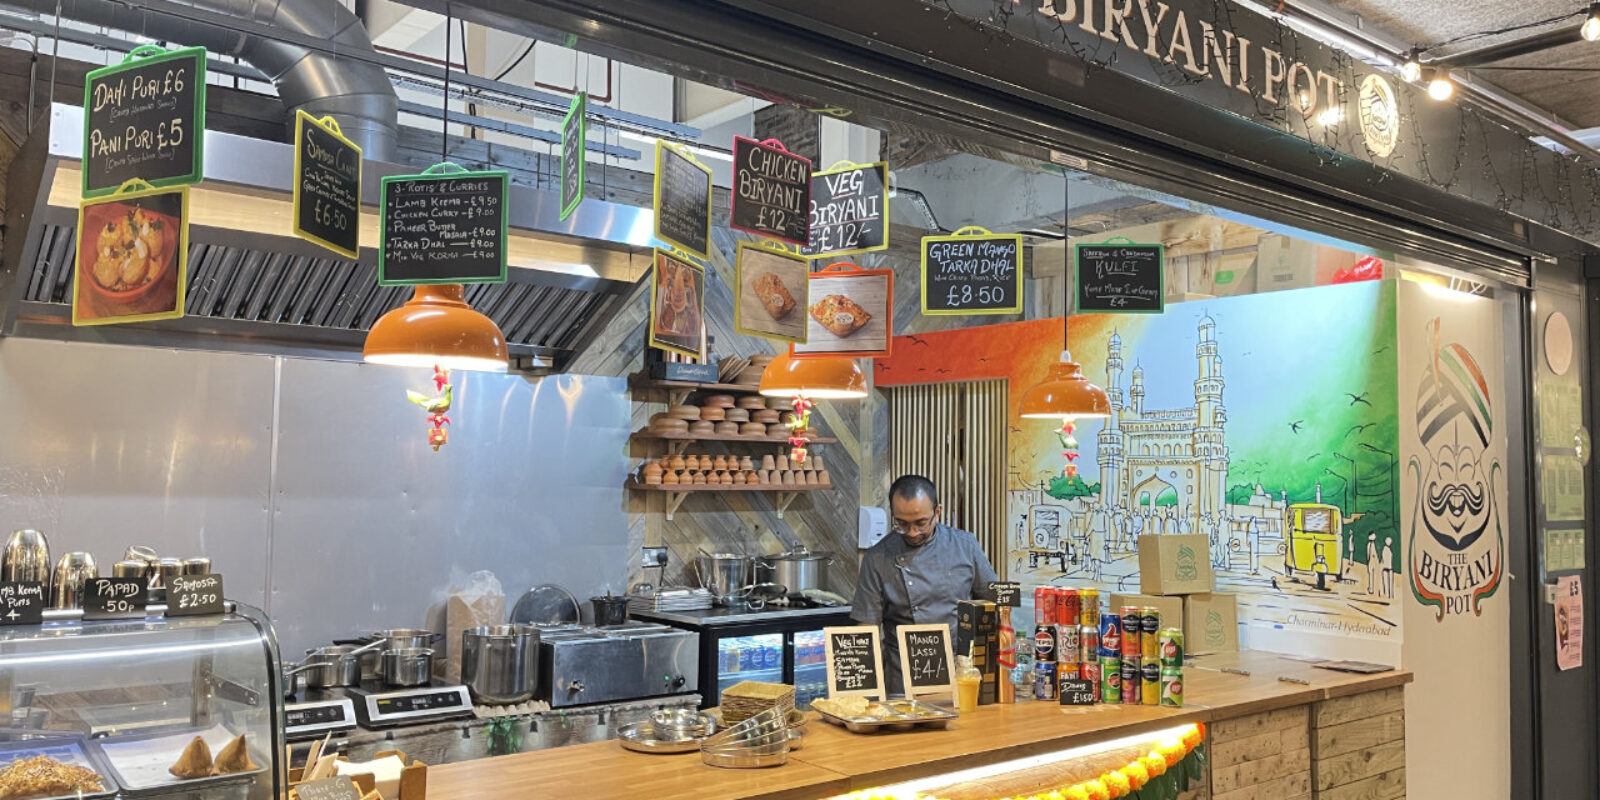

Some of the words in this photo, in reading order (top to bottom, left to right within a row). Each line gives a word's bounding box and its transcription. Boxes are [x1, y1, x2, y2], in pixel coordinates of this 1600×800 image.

[93, 79, 126, 112] DAHI
[131, 75, 160, 100] PURI
[163, 69, 185, 95] £6
[1262, 46, 1342, 118] POT
[90, 129, 121, 158] PANI
[125, 126, 153, 150] PURI
[157, 119, 183, 150] £5
[749, 147, 807, 185] CHICKEN
[449, 181, 488, 192] CURRIES
[739, 169, 803, 213] BIRYANI
[825, 170, 864, 195] VEG
[396, 198, 426, 208] LAMB
[315, 200, 347, 231] £6.50
[394, 210, 428, 219] CHICKEN
[431, 208, 459, 217] CURRY
[393, 220, 427, 233] PANEER
[391, 237, 419, 250] TARKA
[420, 237, 445, 250] DHAL
[929, 243, 975, 262] GREEN
[977, 241, 1015, 258] MANGO
[940, 258, 978, 274] TARKA
[980, 258, 1014, 276] DHAL
[1096, 260, 1139, 279] KULFI
[1448, 553, 1468, 565] THE
[1419, 550, 1493, 591] BIRYANI
[96, 580, 139, 598] PAPAD
[173, 577, 218, 594] SAMOSA
[179, 593, 216, 608] £2.50
[1446, 594, 1472, 615] POT
[1287, 614, 1391, 636] Charminar-Hyderabad
[835, 635, 851, 649] VEG
[910, 633, 940, 645] MANGO
[911, 646, 937, 657] LASSI
